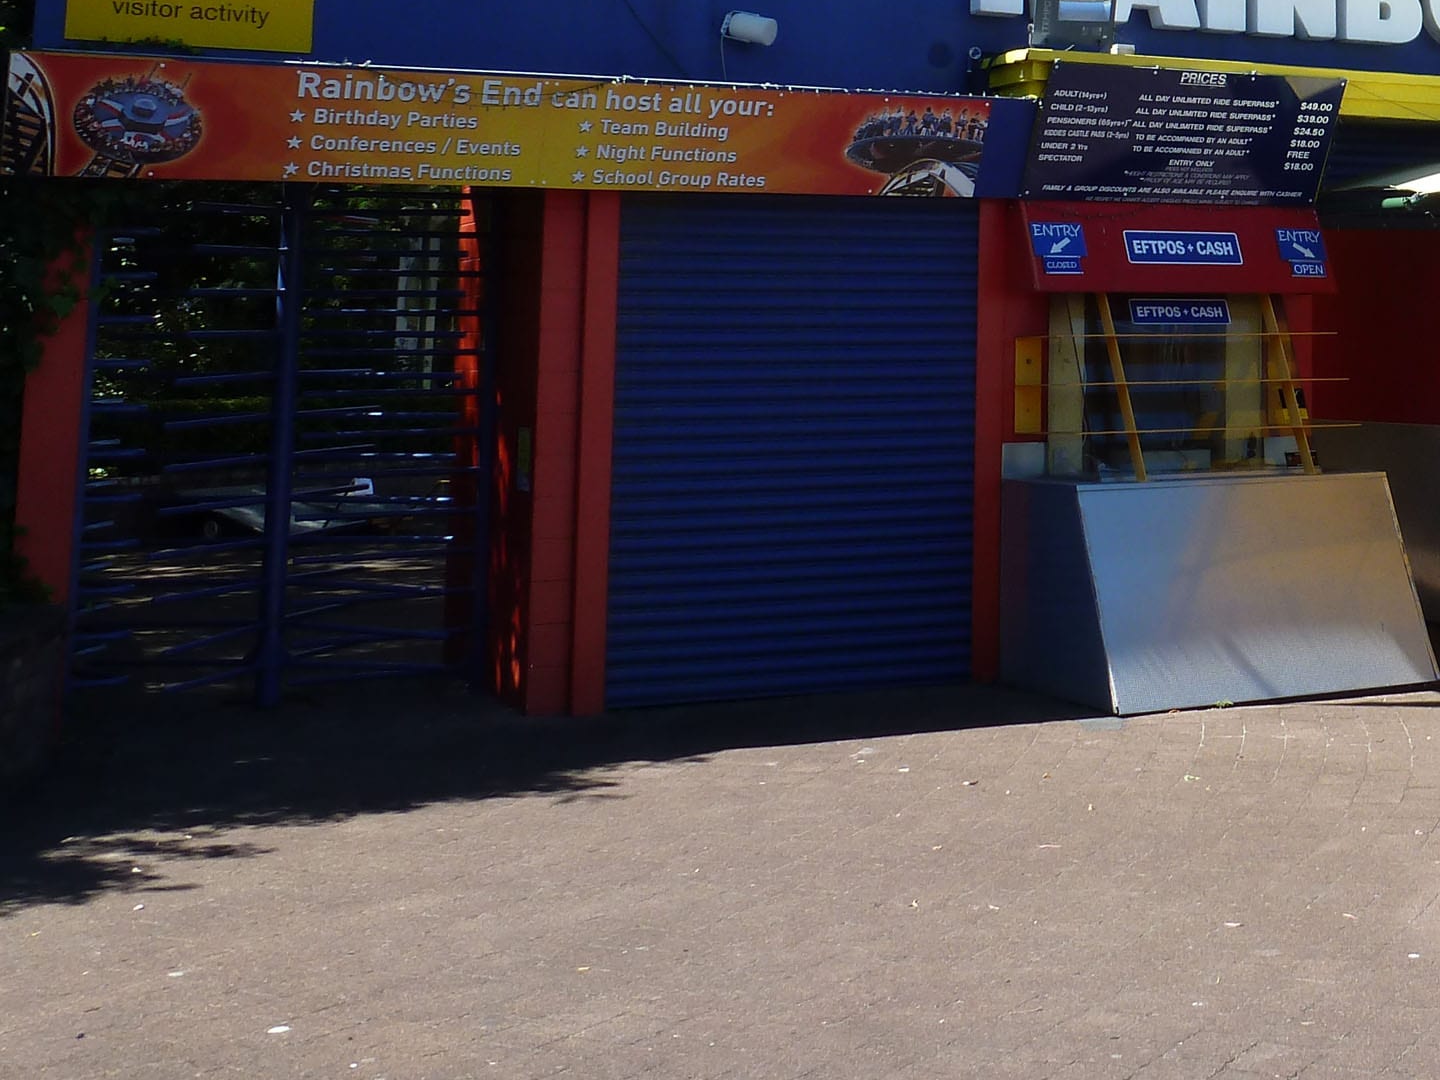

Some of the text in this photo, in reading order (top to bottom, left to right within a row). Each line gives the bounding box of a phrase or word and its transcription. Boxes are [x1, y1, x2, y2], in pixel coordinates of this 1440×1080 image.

[190, 3, 270, 30] activity
[1180, 71, 1228, 85] PRICES
[297, 72, 775, 119] Rainbow's End can host all your:
[1138, 93, 1154, 102] ALL
[1155, 94, 1171, 103] DAY
[1172, 96, 1212, 106] UNLIMITED
[1213, 98, 1231, 107] RIDE
[1050, 103, 1075, 112] CHILD
[1300, 102, 1334, 112] $49.00
[313, 108, 479, 130] Birthday Parties
[1135, 107, 1151, 116] ALL
[1152, 108, 1168, 117] DAY
[1168, 109, 1209, 119] UNLIMITED
[1209, 111, 1228, 120] RIDE
[1297, 114, 1330, 125] $39.00
[1046, 116, 1098, 126] PENSIONERS
[1132, 120, 1147, 129] ALL
[1148, 121, 1164, 130] DAY
[1165, 122, 1205, 132] UNLIMITED
[1206, 124, 1224, 132] RIDE
[601, 119, 730, 141] Team Building
[1293, 127, 1326, 137] $24.50
[1135, 133, 1146, 141] TO
[310, 134, 522, 157] Conferences / Events
[1041, 142, 1068, 151] UNDER
[1132, 145, 1143, 153] TO
[1289, 139, 1321, 149] $18.00
[596, 145, 737, 164] Night Functions
[1038, 154, 1084, 163] SPECTATOR
[1287, 150, 1311, 160] FREE
[1168, 158, 1215, 168] ENTRY ONLY
[1283, 162, 1314, 171] $18.00
[307, 160, 512, 182] Christmas Functions
[592, 169, 767, 189] School Group Rates
[1032, 223, 1082, 238] ENTRY
[1276, 229, 1322, 244] ENTRY
[1132, 239, 1186, 256] EFTPOS
[1195, 240, 1234, 257] CASH
[1046, 259, 1077, 270] CLOSED
[1293, 263, 1324, 275] OPEN
[1136, 306, 1181, 318] EFTPOS
[1191, 306, 1223, 318] CASH
